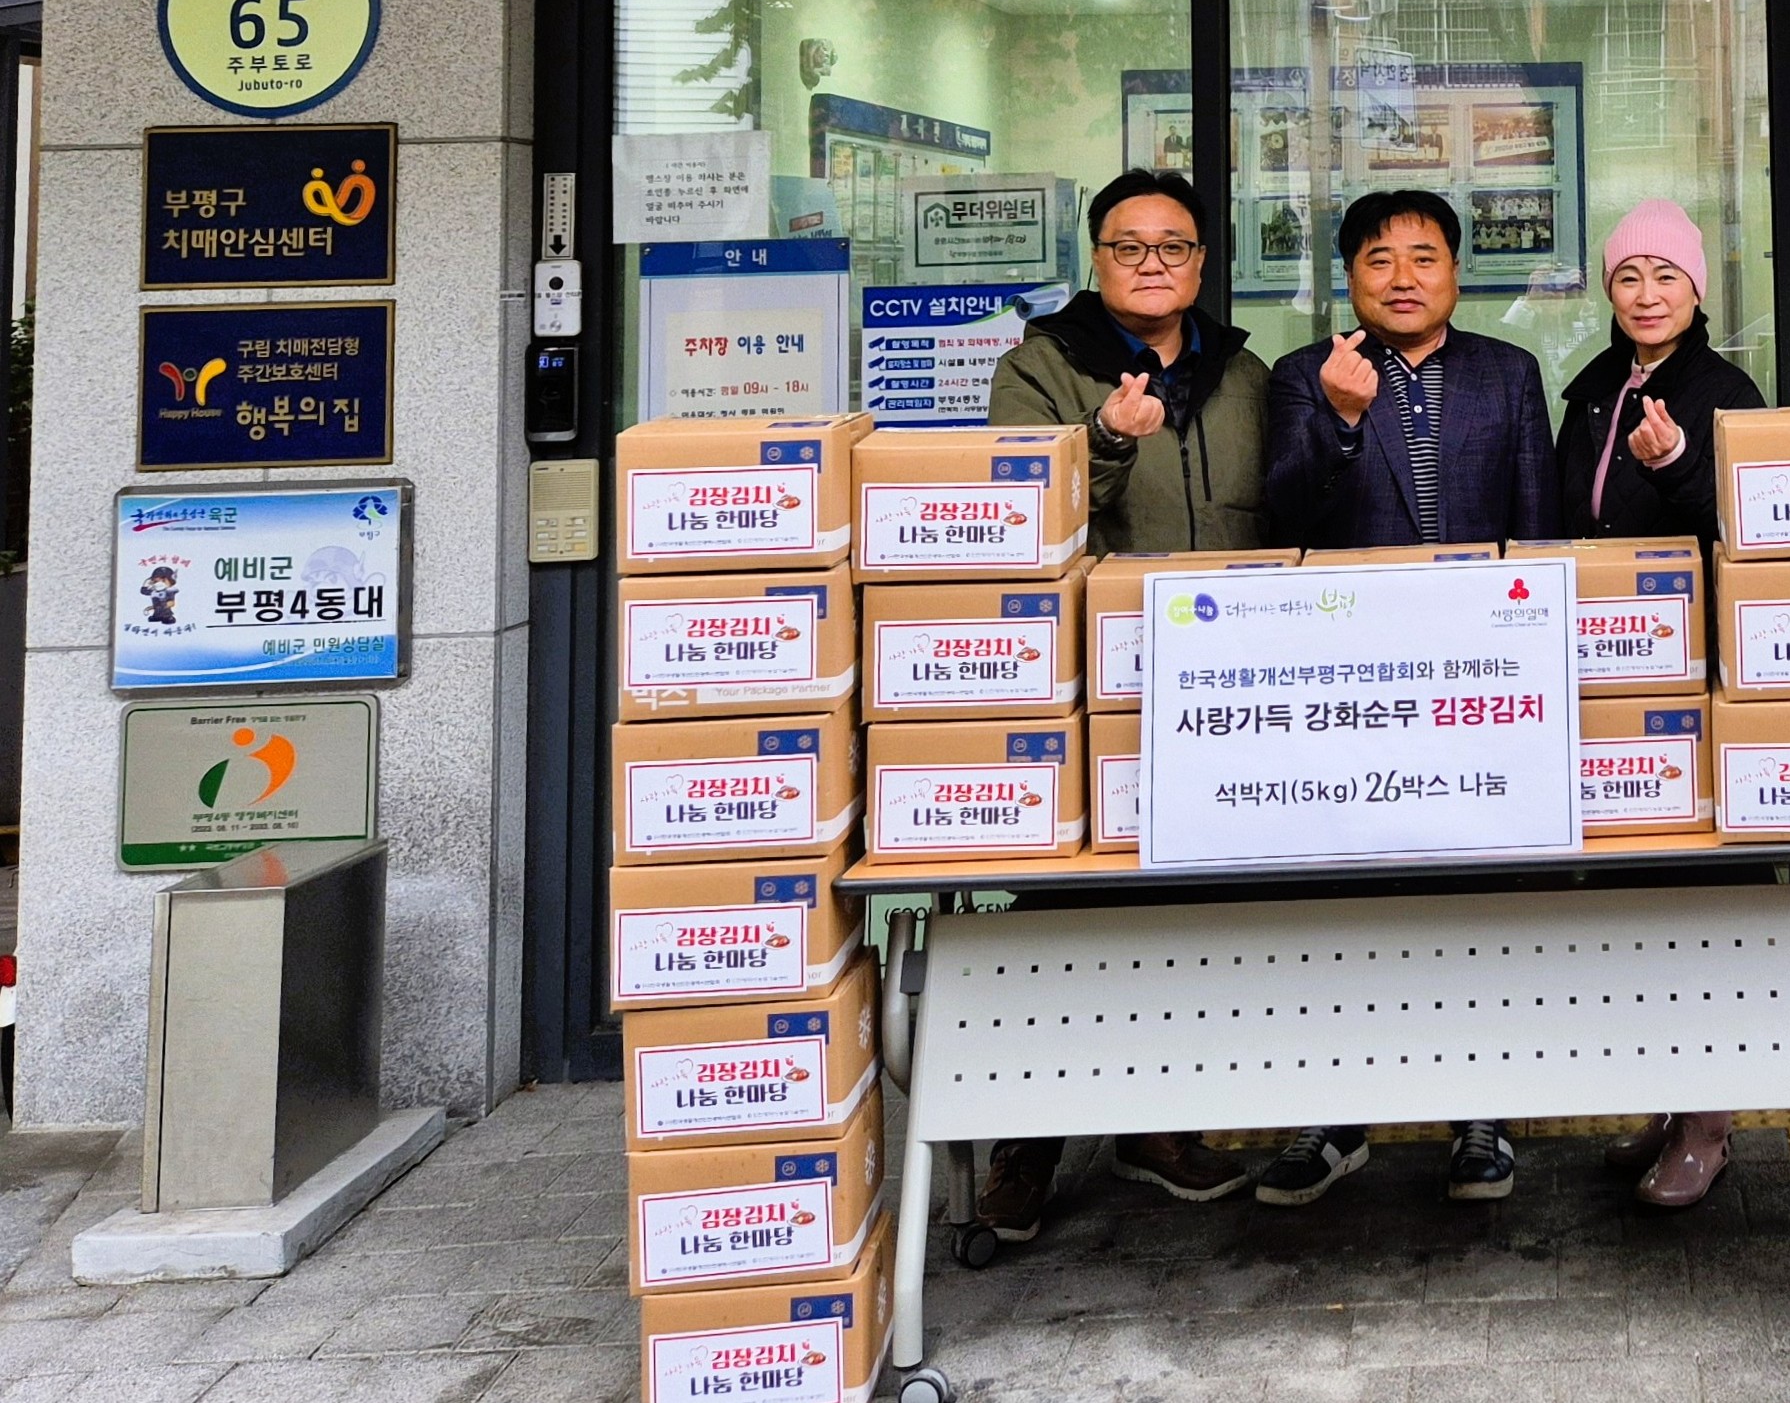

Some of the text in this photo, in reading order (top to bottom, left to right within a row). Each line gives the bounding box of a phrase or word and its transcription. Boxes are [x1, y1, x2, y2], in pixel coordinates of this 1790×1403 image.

[227, 54, 313, 75] 주부토로
[238, 79, 303, 92] Jubuto-ro
[163, 188, 248, 219] 부평구
[950, 198, 1037, 220] 무더위쉼터
[161, 226, 334, 259] 치매안심센터
[869, 295, 1003, 318] CCTV 설치안내
[236, 337, 361, 358] 구립 치매전담형
[684, 333, 804, 357] 주차장 이용 안내
[236, 362, 339, 383] 주간보호센터
[938, 378, 969, 388] 24시간
[743, 382, 769, 395] 09시
[785, 379, 810, 393] 18시
[159, 408, 190, 420] Happy
[235, 395, 360, 441] 행복의 집
[689, 486, 772, 507] 김장김치
[208, 507, 238, 524] 육군
[668, 509, 779, 531] 나눔 한마당
[920, 502, 1000, 521] 김장김치
[899, 524, 1006, 544] 나눔 한마당
[214, 556, 293, 582] 예비군
[214, 585, 385, 624] 부평4동대
[687, 617, 771, 638] 김장김치
[262, 636, 386, 656] 예비군 민원상담실
[665, 640, 778, 663] 나눔 한마당
[933, 638, 1013, 658] 김장김치
[1594, 637, 1655, 658] 한마당
[912, 660, 1020, 681] 나눔 한마당
[1177, 658, 1521, 690] 한국생활개선부평구연합회와 함께하는
[715, 682, 832, 698] Your Package Partner
[190, 716, 224, 726] Barrier
[226, 715, 248, 724] Free
[1176, 694, 1545, 738] 사랑가득 강화순무 김장김치
[687, 777, 771, 799] 김장김치
[934, 783, 1015, 803] 김장김치
[1214, 777, 1359, 808] 석박지(5kg)
[1459, 771, 1509, 798] 나눔
[1602, 779, 1662, 800] 한마당
[665, 799, 778, 824] 나눔 한마당
[913, 806, 1021, 826] 나눔 한마당
[677, 925, 761, 947] 김장김치
[654, 948, 768, 972] 나눔 한마당
[697, 1059, 781, 1083] 김장김치
[676, 1082, 788, 1109] 나눔 한마당
[702, 1204, 786, 1230] 김장김치
[680, 1227, 794, 1256] 나눔 한마당
[712, 1344, 796, 1370] 김장김치
[690, 1366, 804, 1396] 나눔 한마당
